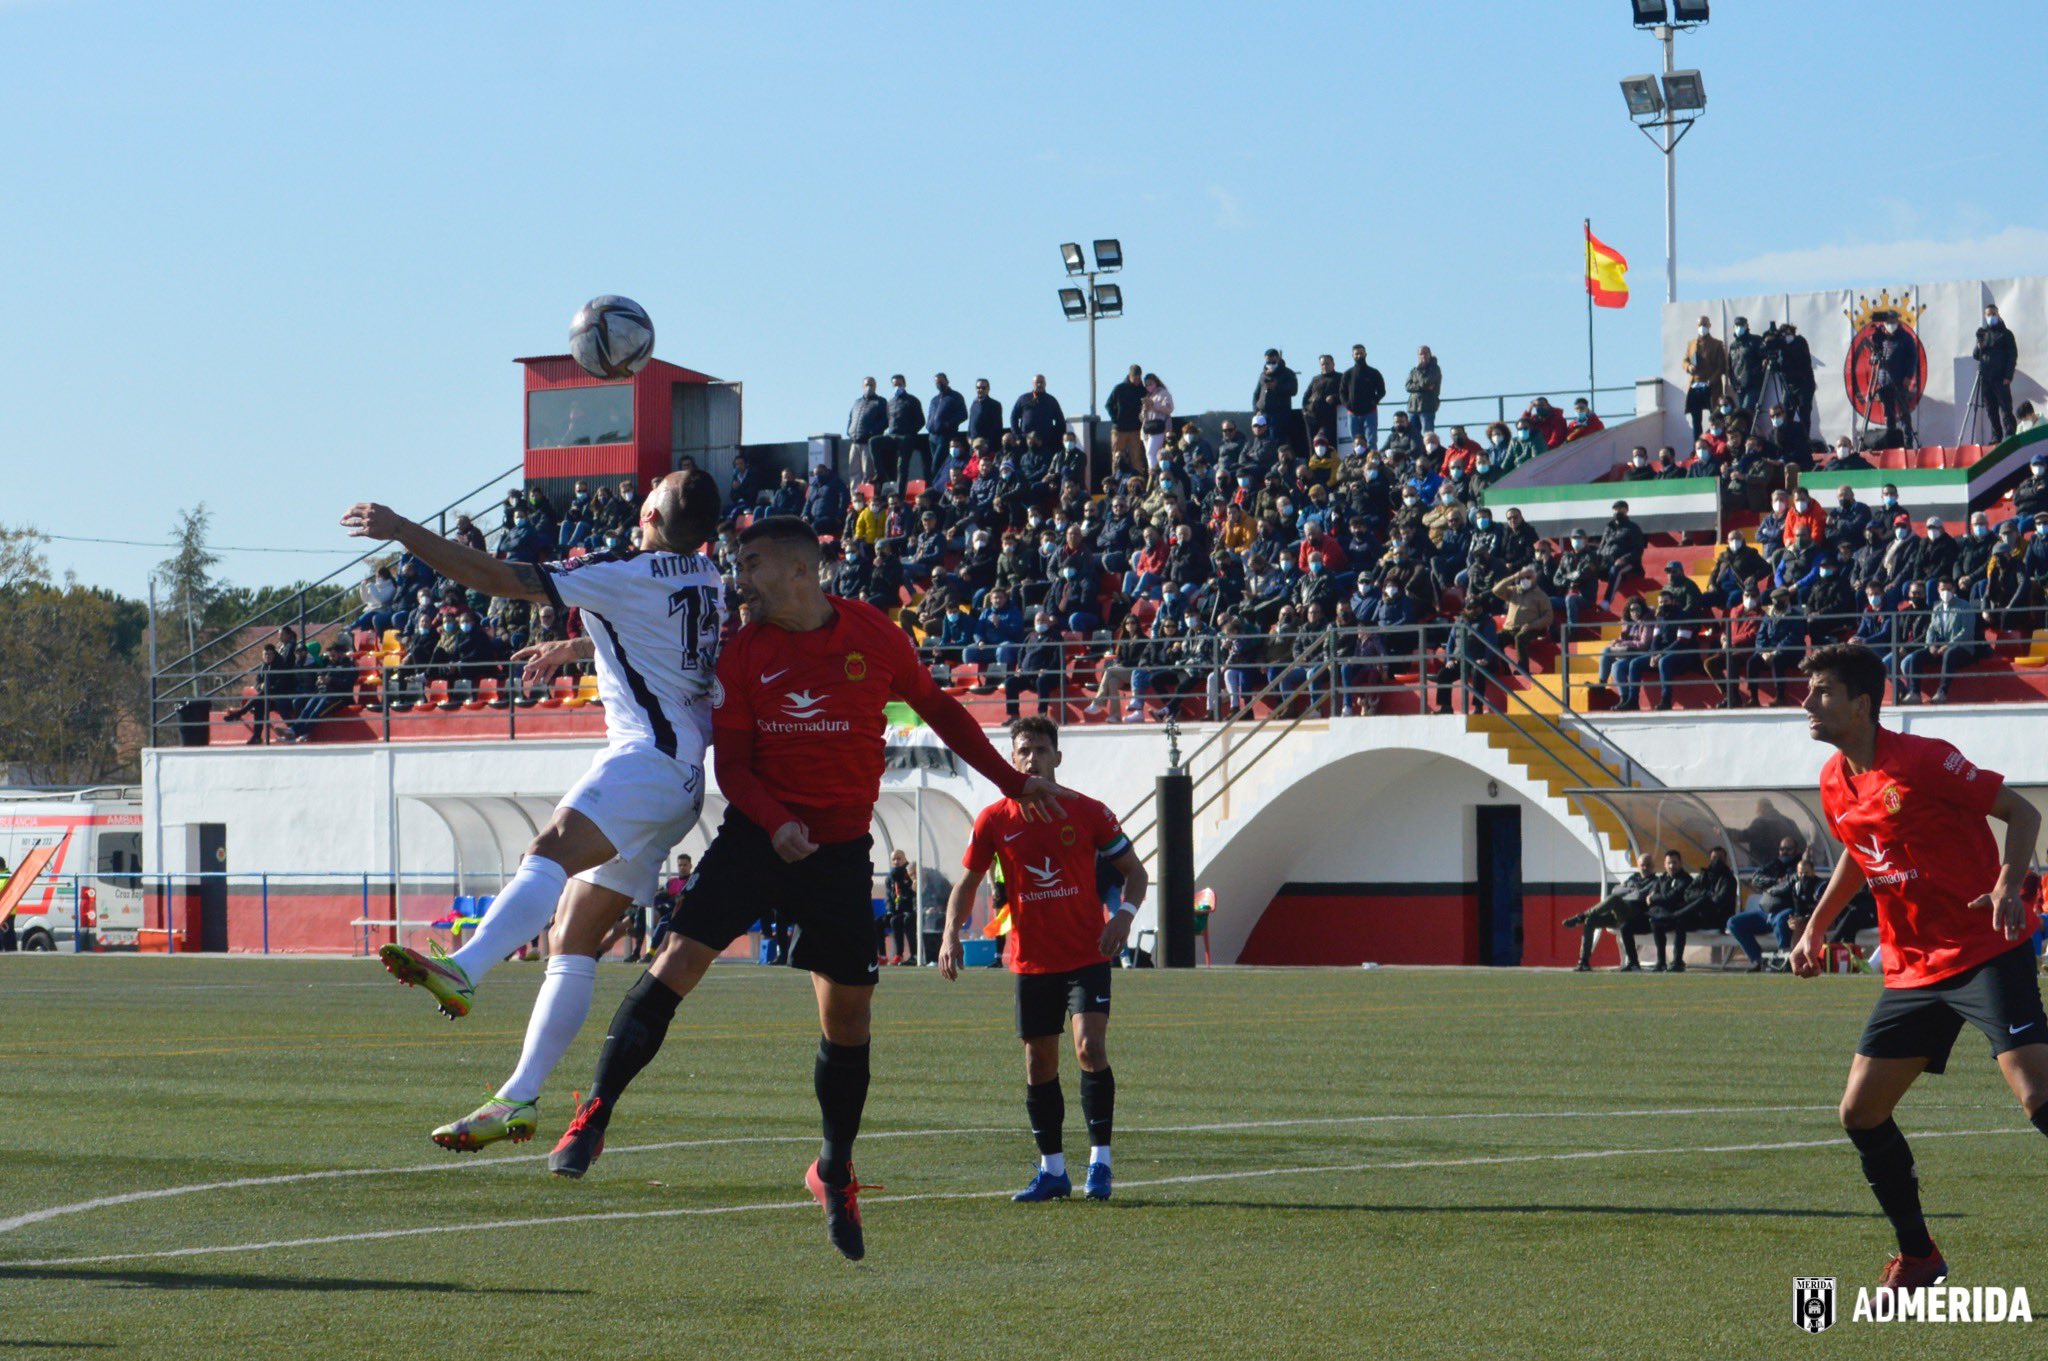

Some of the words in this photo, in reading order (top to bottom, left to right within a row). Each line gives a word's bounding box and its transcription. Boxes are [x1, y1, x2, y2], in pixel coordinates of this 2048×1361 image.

[650, 555, 699, 577] AITOR
[668, 585, 720, 671] 15
[1866, 869, 1918, 888] tremadura
[1018, 886, 1079, 902] Extremadura
